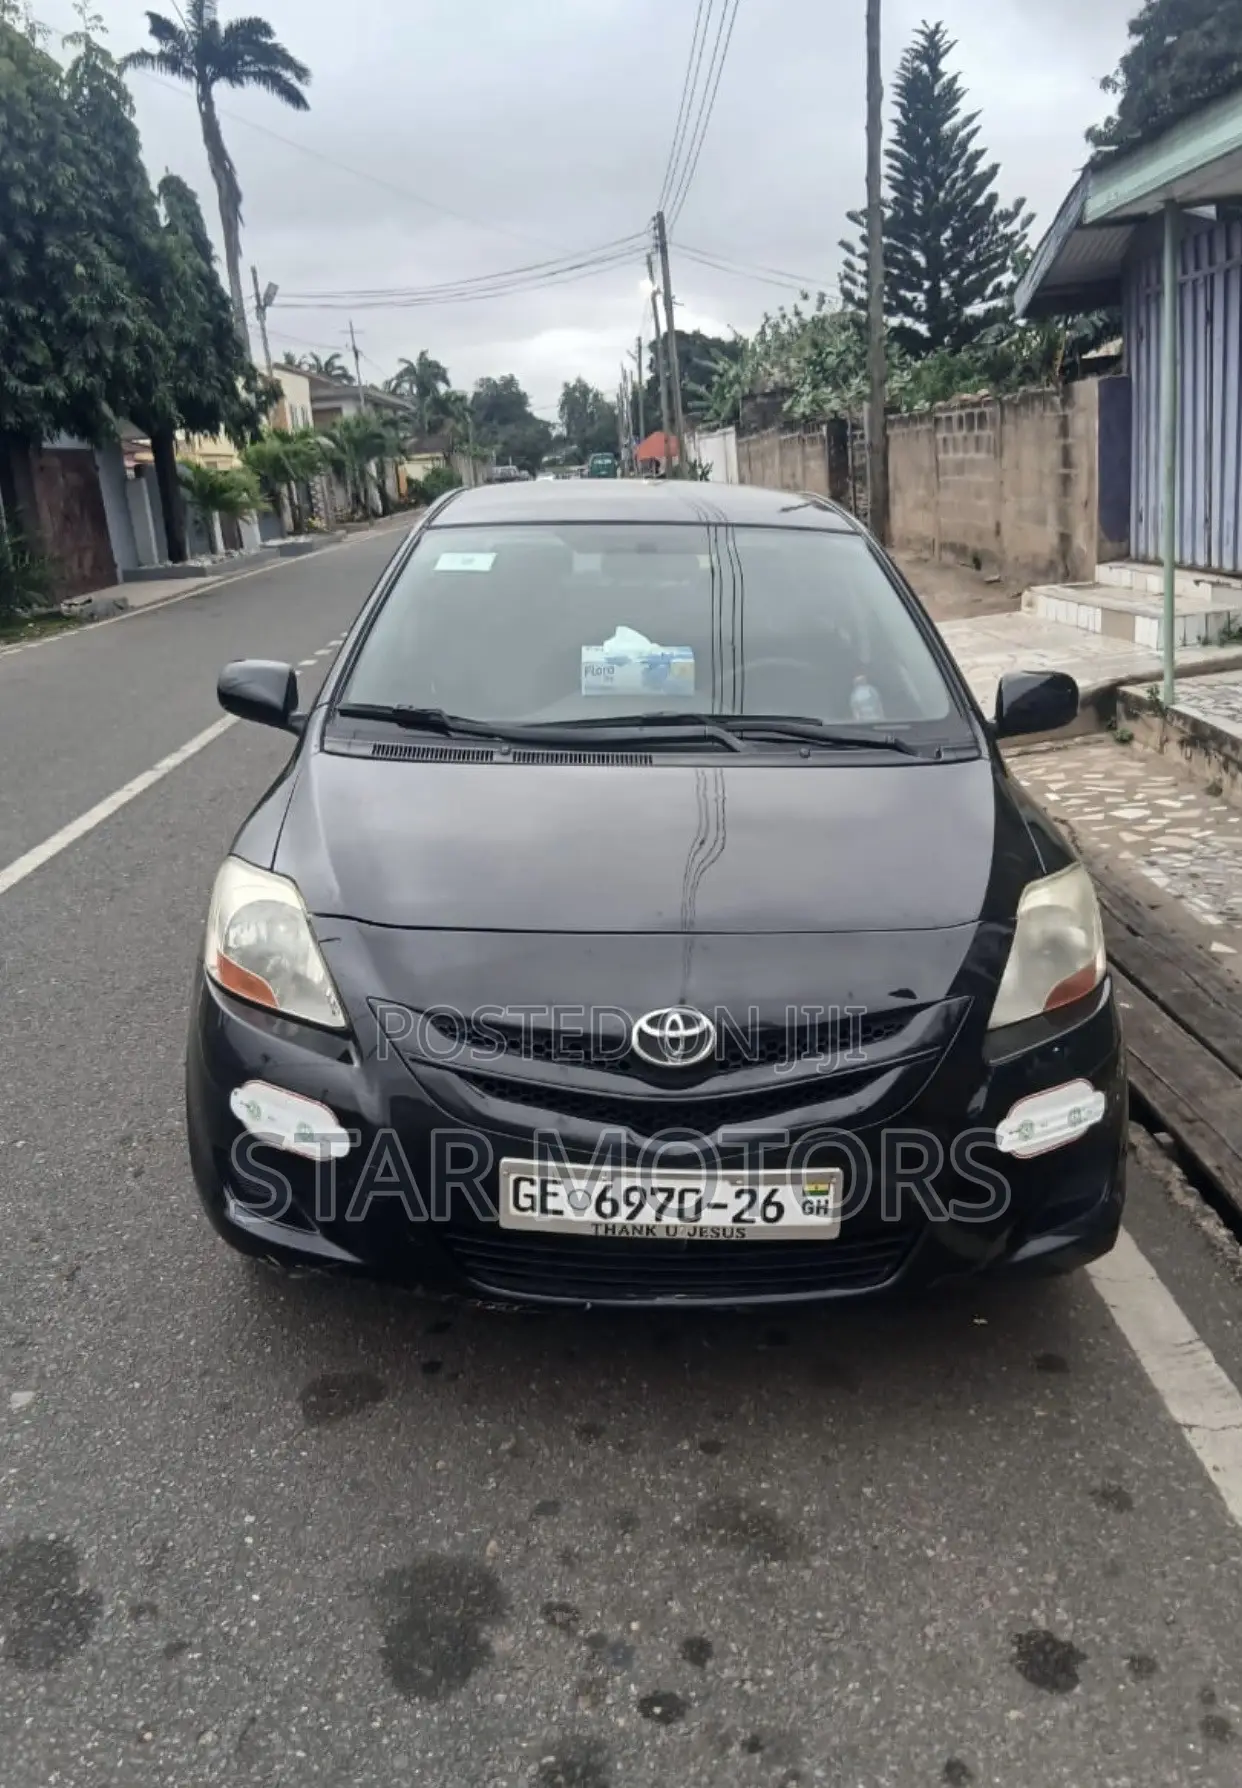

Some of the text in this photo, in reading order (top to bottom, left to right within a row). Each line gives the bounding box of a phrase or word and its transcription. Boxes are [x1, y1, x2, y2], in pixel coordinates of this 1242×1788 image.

[512, 1176, 785, 1224] GE 6970-26
[802, 1199, 830, 1217] GH
[591, 1223, 747, 1239] THANK U JESUS
